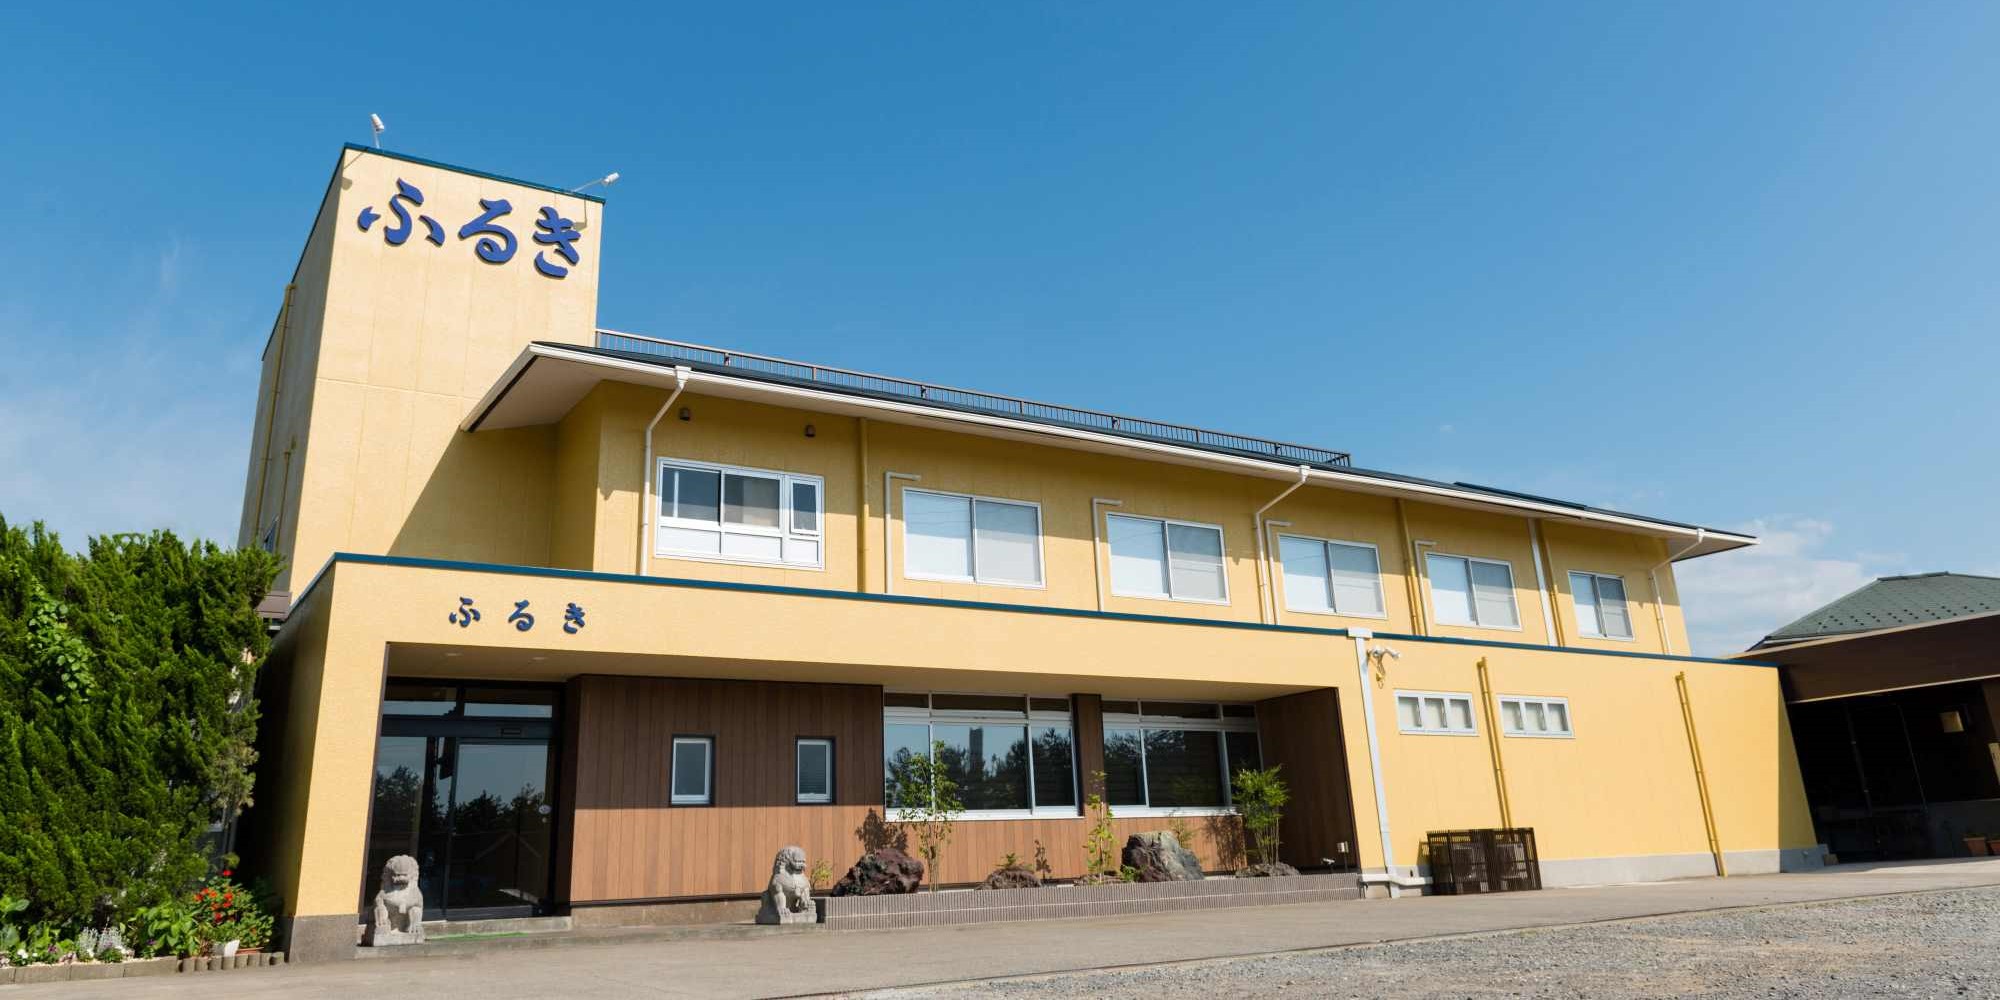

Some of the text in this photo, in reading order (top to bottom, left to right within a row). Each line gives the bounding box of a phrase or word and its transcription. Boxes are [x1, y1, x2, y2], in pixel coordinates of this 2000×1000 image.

[358, 178, 582, 279] ふるき
[449, 597, 585, 634] ふるき
